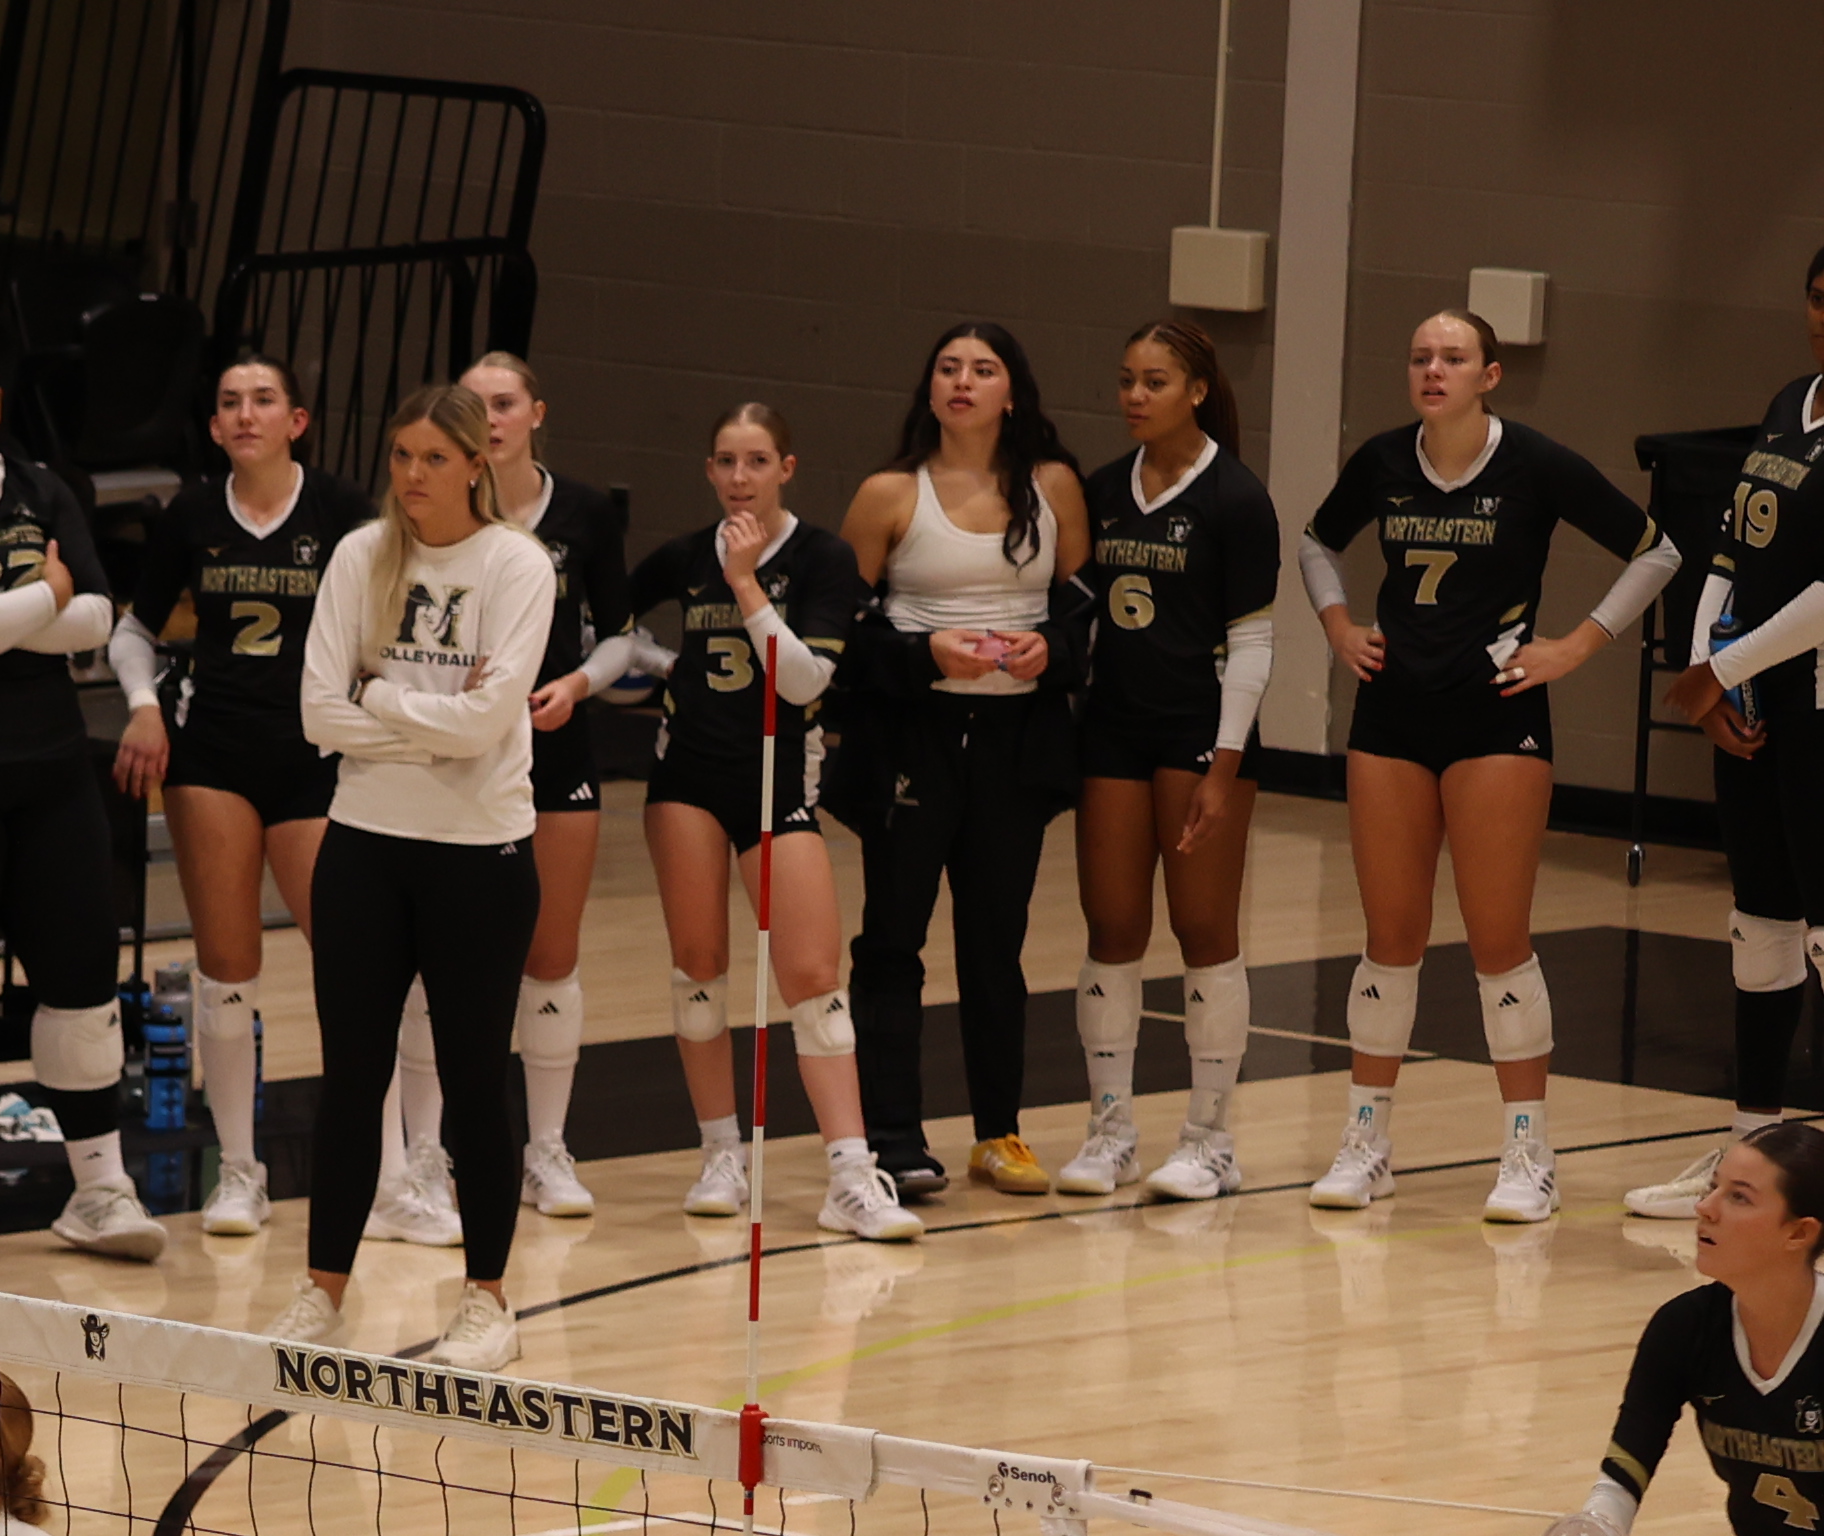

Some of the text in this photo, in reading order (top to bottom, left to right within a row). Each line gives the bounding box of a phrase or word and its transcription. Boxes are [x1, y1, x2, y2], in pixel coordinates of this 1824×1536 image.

[1385, 515, 1497, 546] NORTHEASTERN
[1733, 481, 1778, 549] 19
[1109, 573, 1156, 631] 6
[1404, 549, 1458, 606] 7
[231, 602, 283, 657] 2
[706, 636, 754, 693] 3
[273, 1340, 698, 1460] NORTHEASTERN
[761, 1433, 786, 1447] ports
[1010, 1466, 1058, 1485] Senoh
[1752, 1472, 1820, 1531] 4
